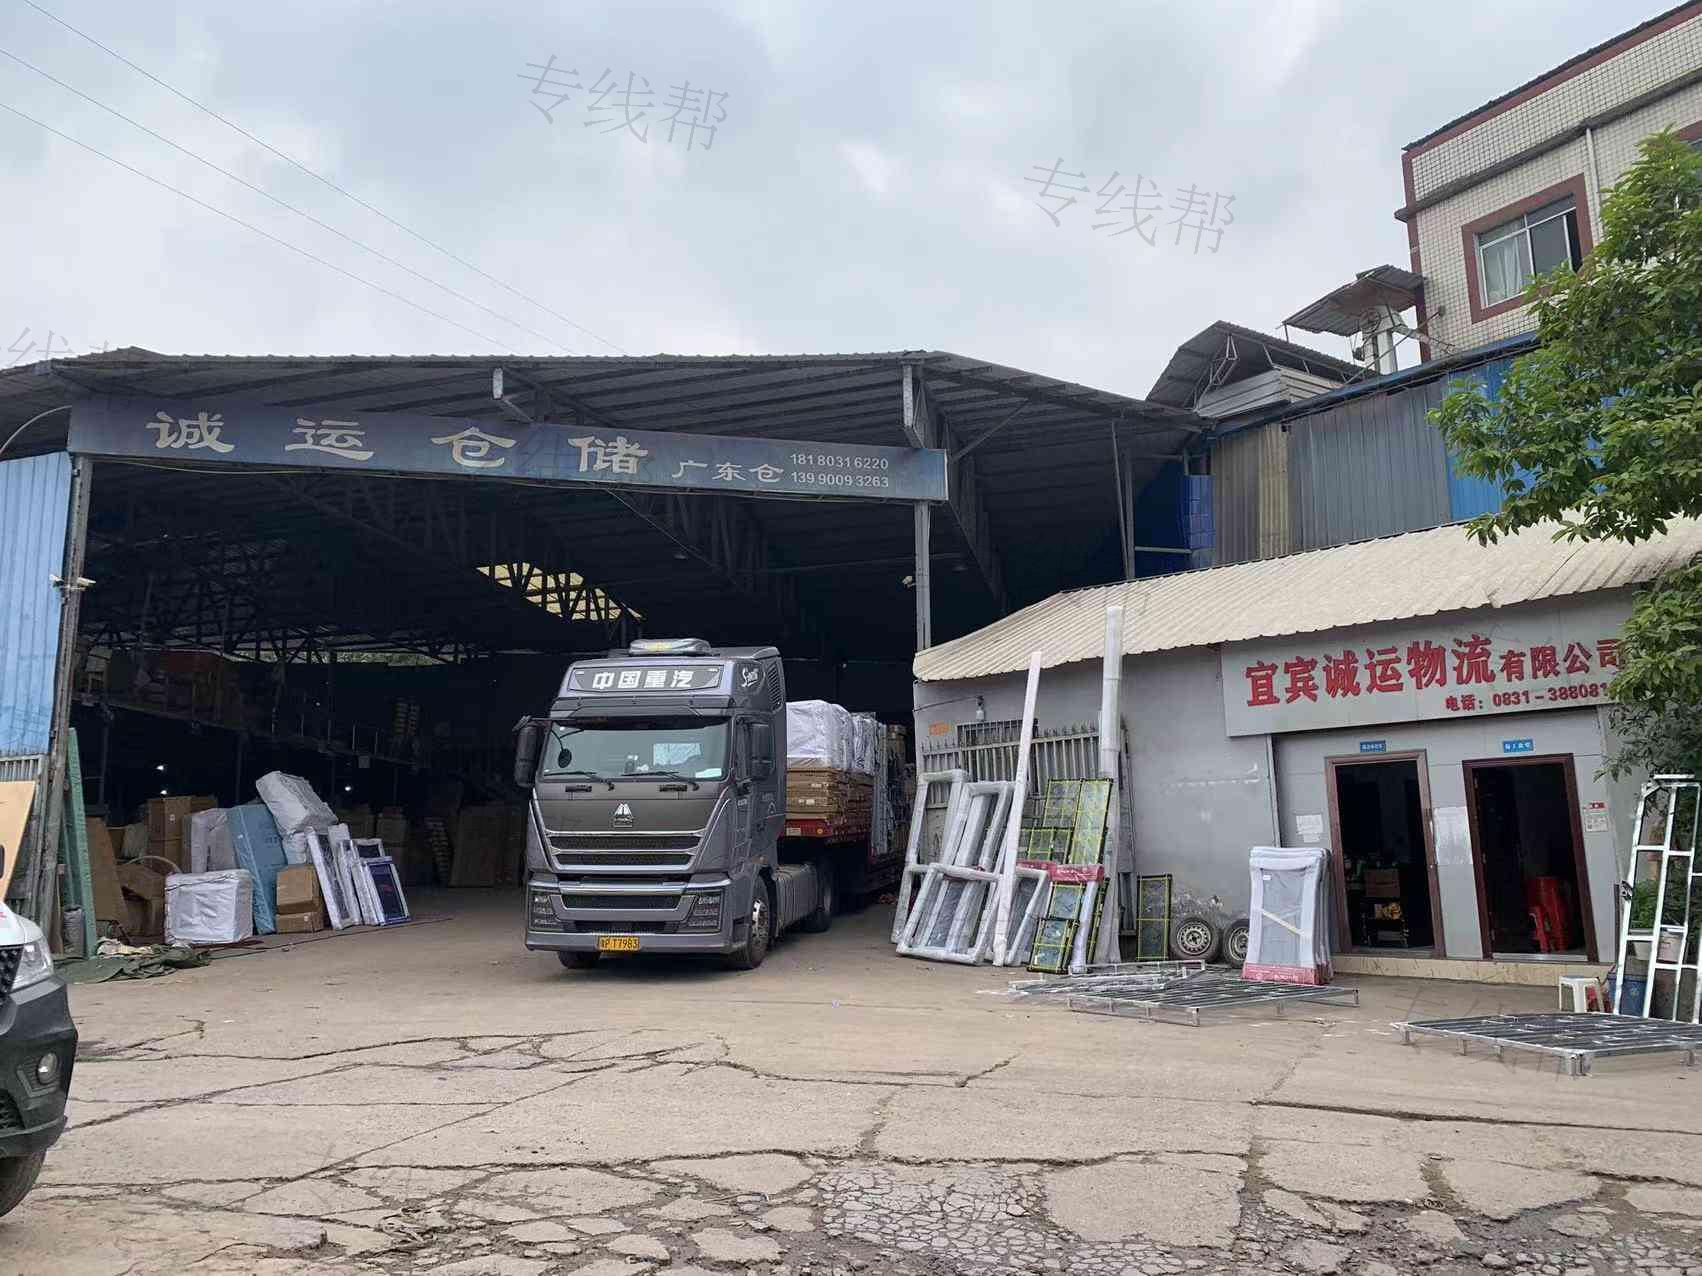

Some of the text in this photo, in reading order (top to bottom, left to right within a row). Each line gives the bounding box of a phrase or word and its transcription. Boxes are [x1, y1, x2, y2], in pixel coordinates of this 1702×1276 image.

[671, 459, 784, 483] 广东仓
[592, 669, 695, 690] 中国重汽
